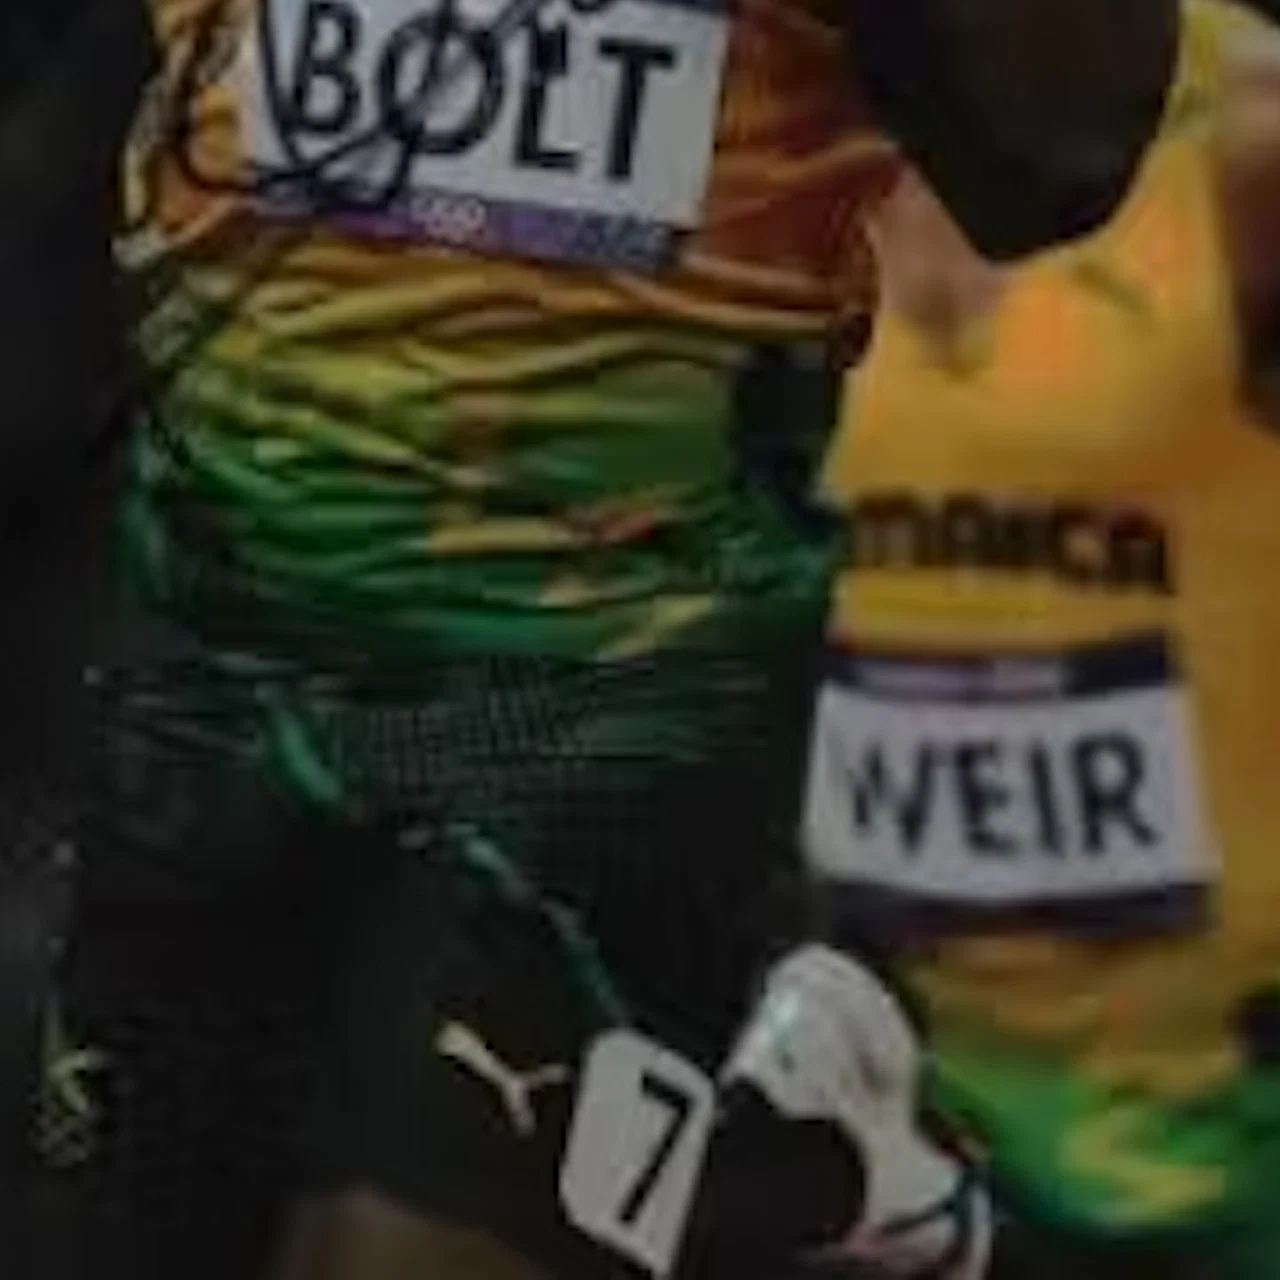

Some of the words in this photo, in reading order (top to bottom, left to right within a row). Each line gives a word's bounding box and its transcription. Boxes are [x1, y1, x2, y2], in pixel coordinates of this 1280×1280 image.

[294, 0, 675, 179] BOLT
[840, 728, 1164, 858] WEIR
[622, 1066, 694, 1224] 7
